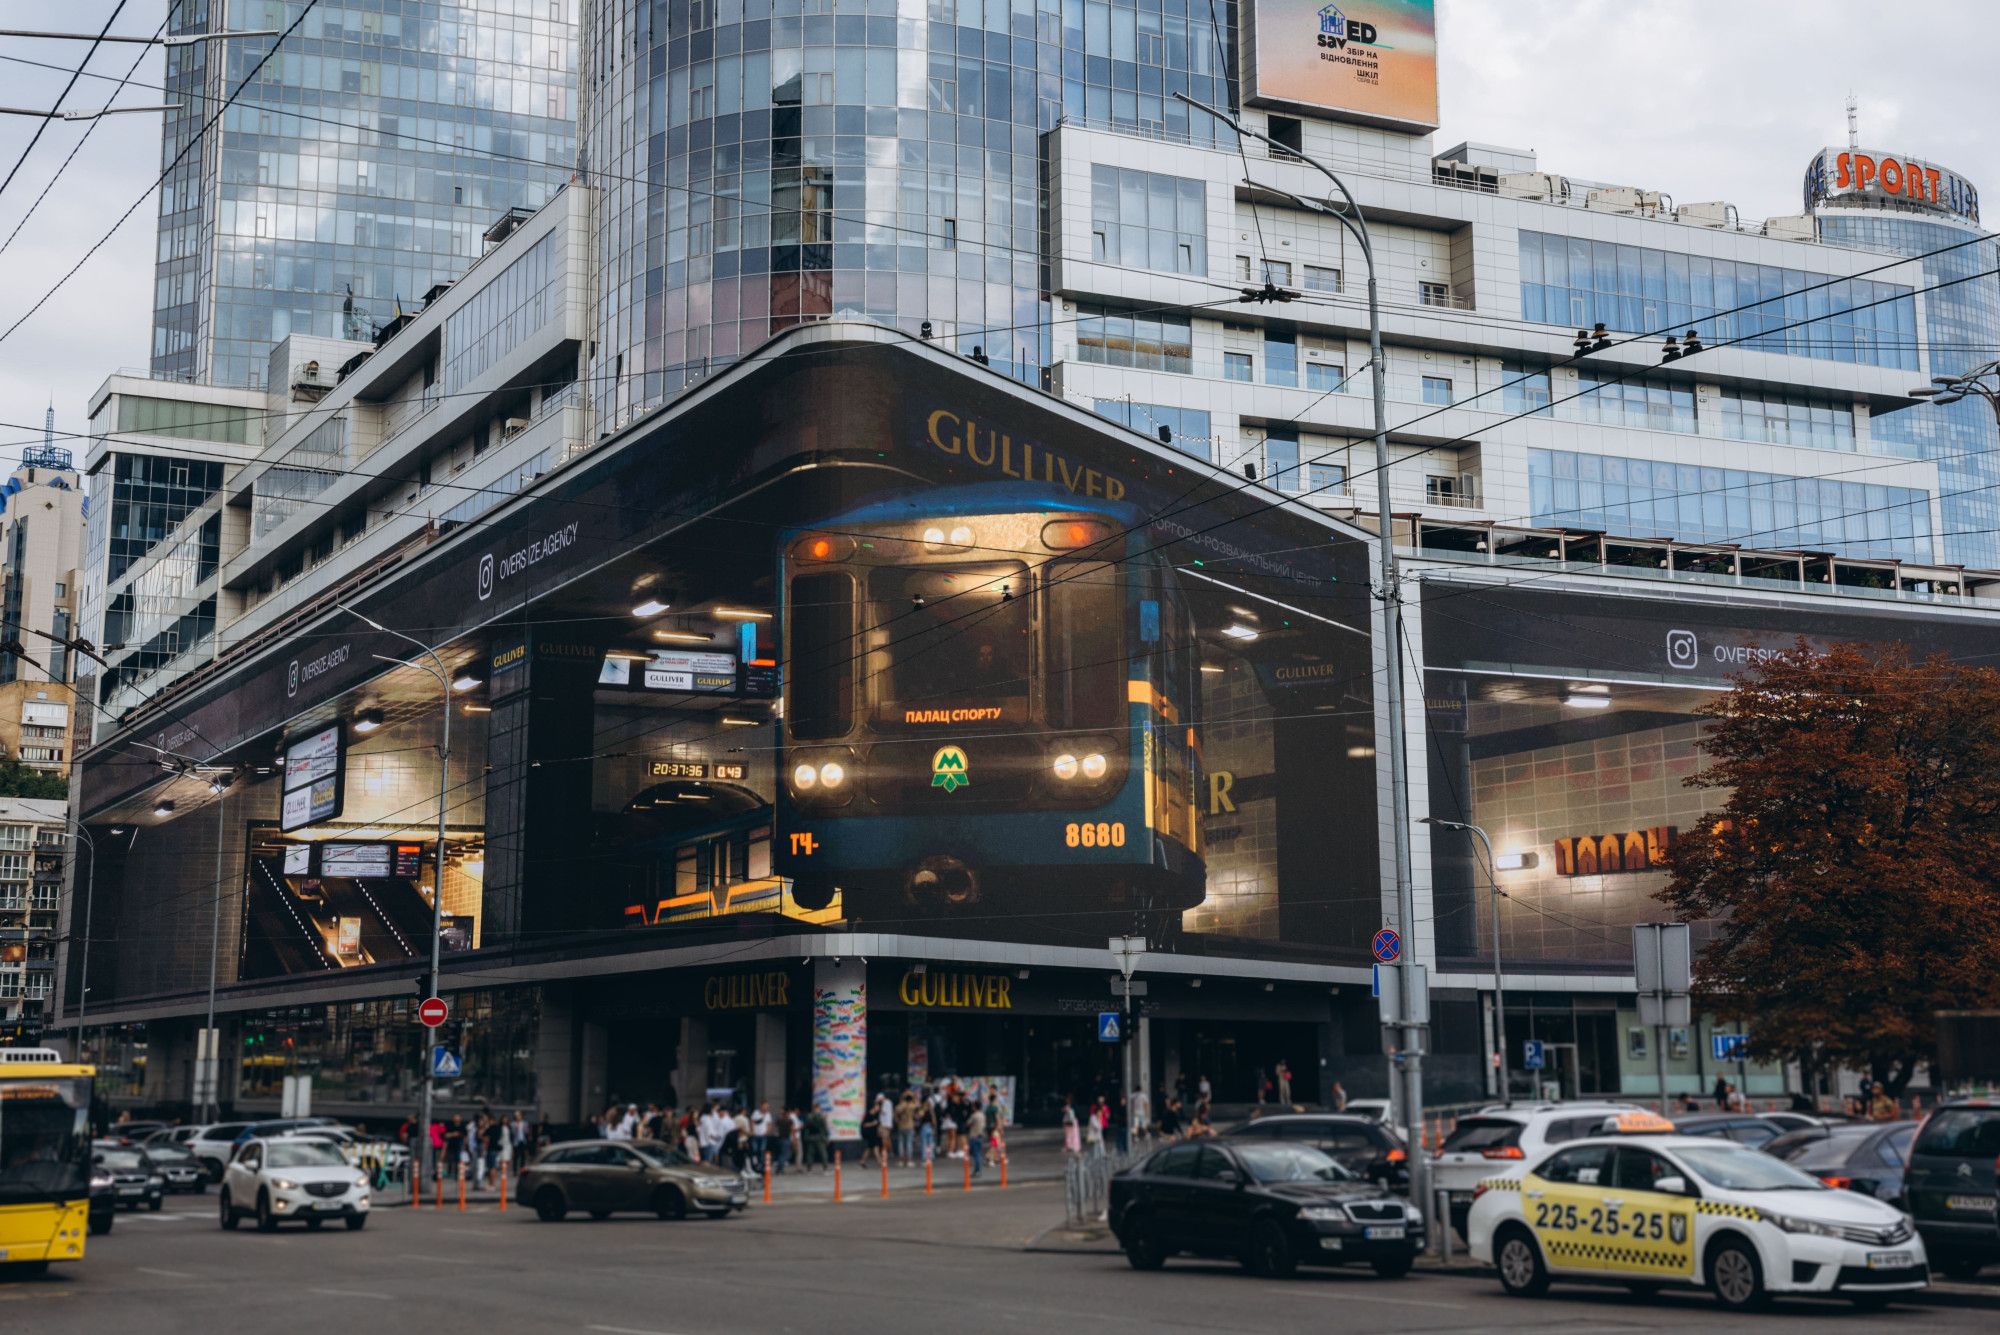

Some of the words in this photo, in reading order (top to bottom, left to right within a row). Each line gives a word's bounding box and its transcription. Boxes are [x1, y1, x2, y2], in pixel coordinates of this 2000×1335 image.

[1320, 52, 1378, 69] ВІДНОВЛЕННЯ
[1347, 48, 1365, 56] ЗБІР
[1367, 51, 1378, 59] НА
[1357, 69, 1378, 79] ШКІЛ
[1836, 152, 1940, 204] SPORT
[927, 409, 1126, 501] GULLIVER
[493, 644, 526, 668] GULLIVER
[650, 674, 684, 683] GULLIVER
[697, 677, 731, 686] GULLIVER
[1275, 664, 1334, 679] GULLIVER
[905, 710, 949, 724] ПАЛАЦ
[951, 707, 1001, 721] СПОРТУ
[653, 763, 703, 777] 20:37:36
[1065, 822, 1126, 849] 8680
[704, 972, 789, 1010] GULLIVER
[900, 971, 1012, 1009] GULLIVER
[1536, 1203, 1664, 1241] 225-25-25
